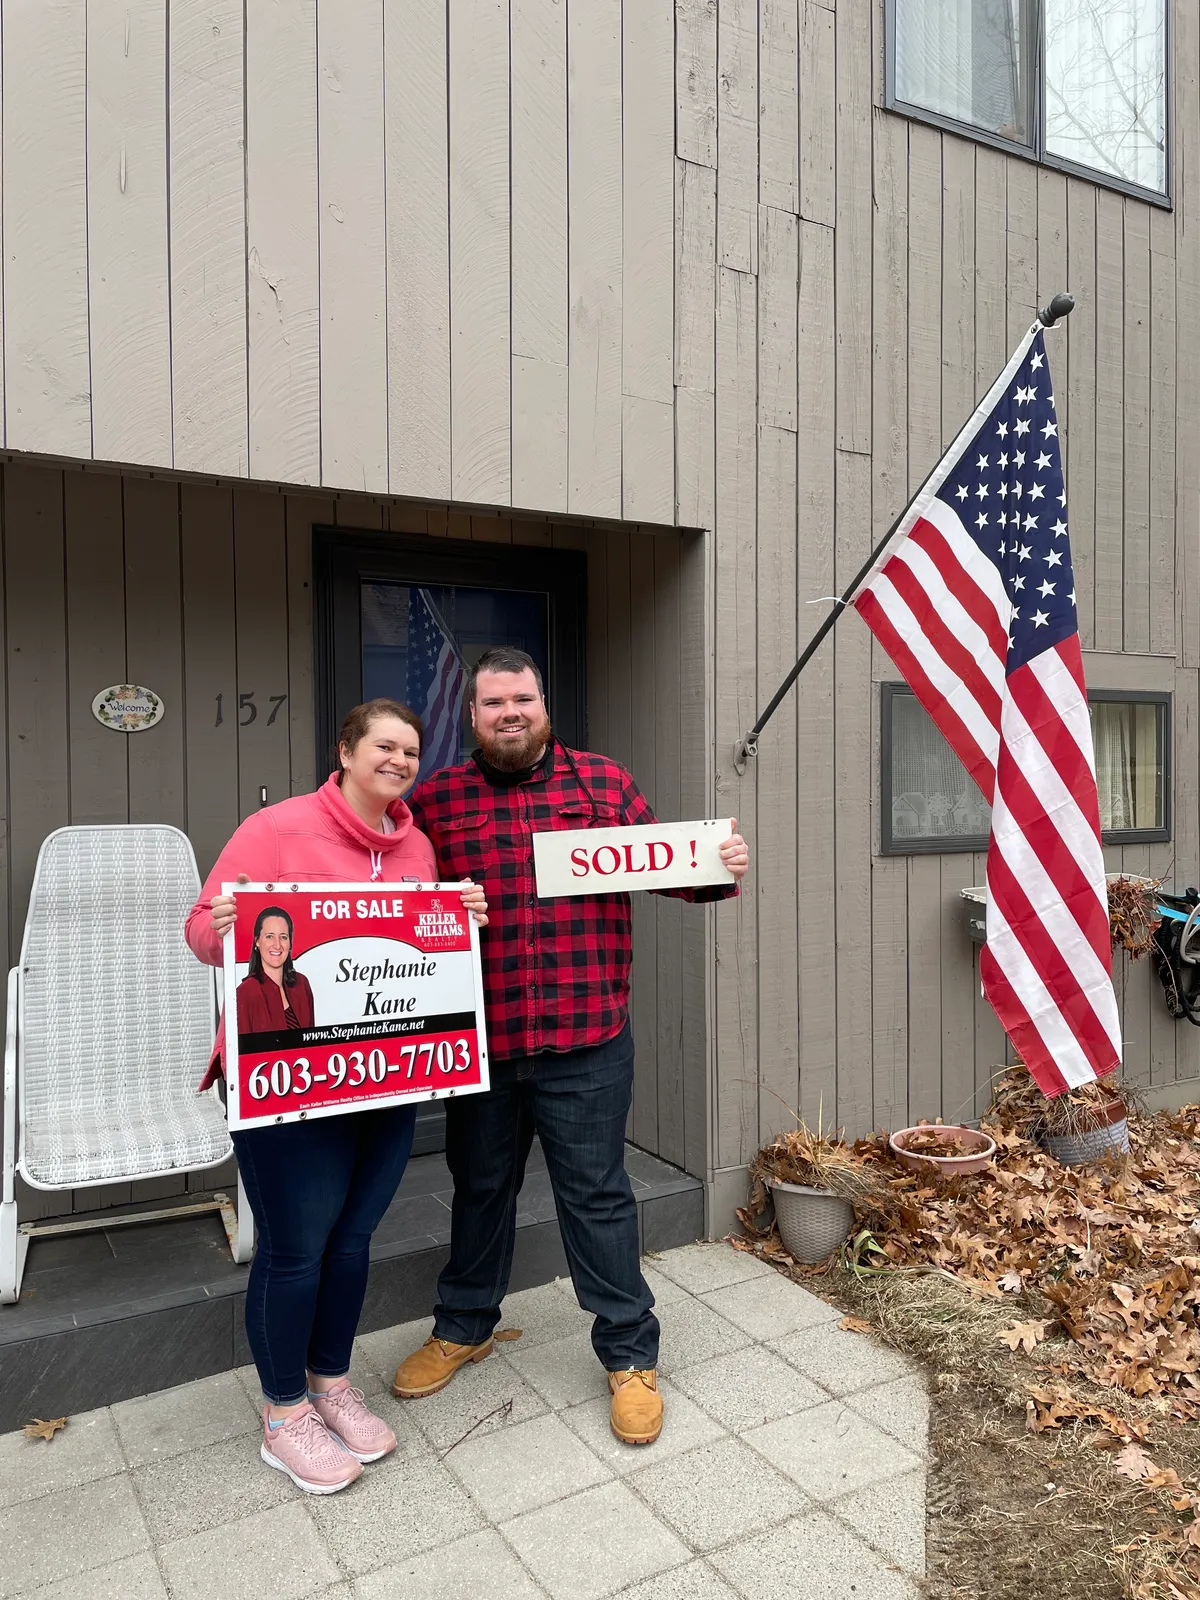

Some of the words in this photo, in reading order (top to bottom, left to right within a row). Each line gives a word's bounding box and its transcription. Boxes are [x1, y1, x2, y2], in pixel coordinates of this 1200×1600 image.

[108, 701, 150, 713] Welcome
[215, 692, 287, 727] 157
[570, 841, 674, 877] SOLD
[310, 900, 351, 920] FOR
[356, 899, 404, 919] SALE
[418, 913, 457, 925] KELLER
[335, 956, 437, 987] Stephanie
[362, 991, 416, 1016] Kane
[302, 1019, 425, 1042] www.StephanieKane.net
[248, 1038, 472, 1101] 603-930-7703
